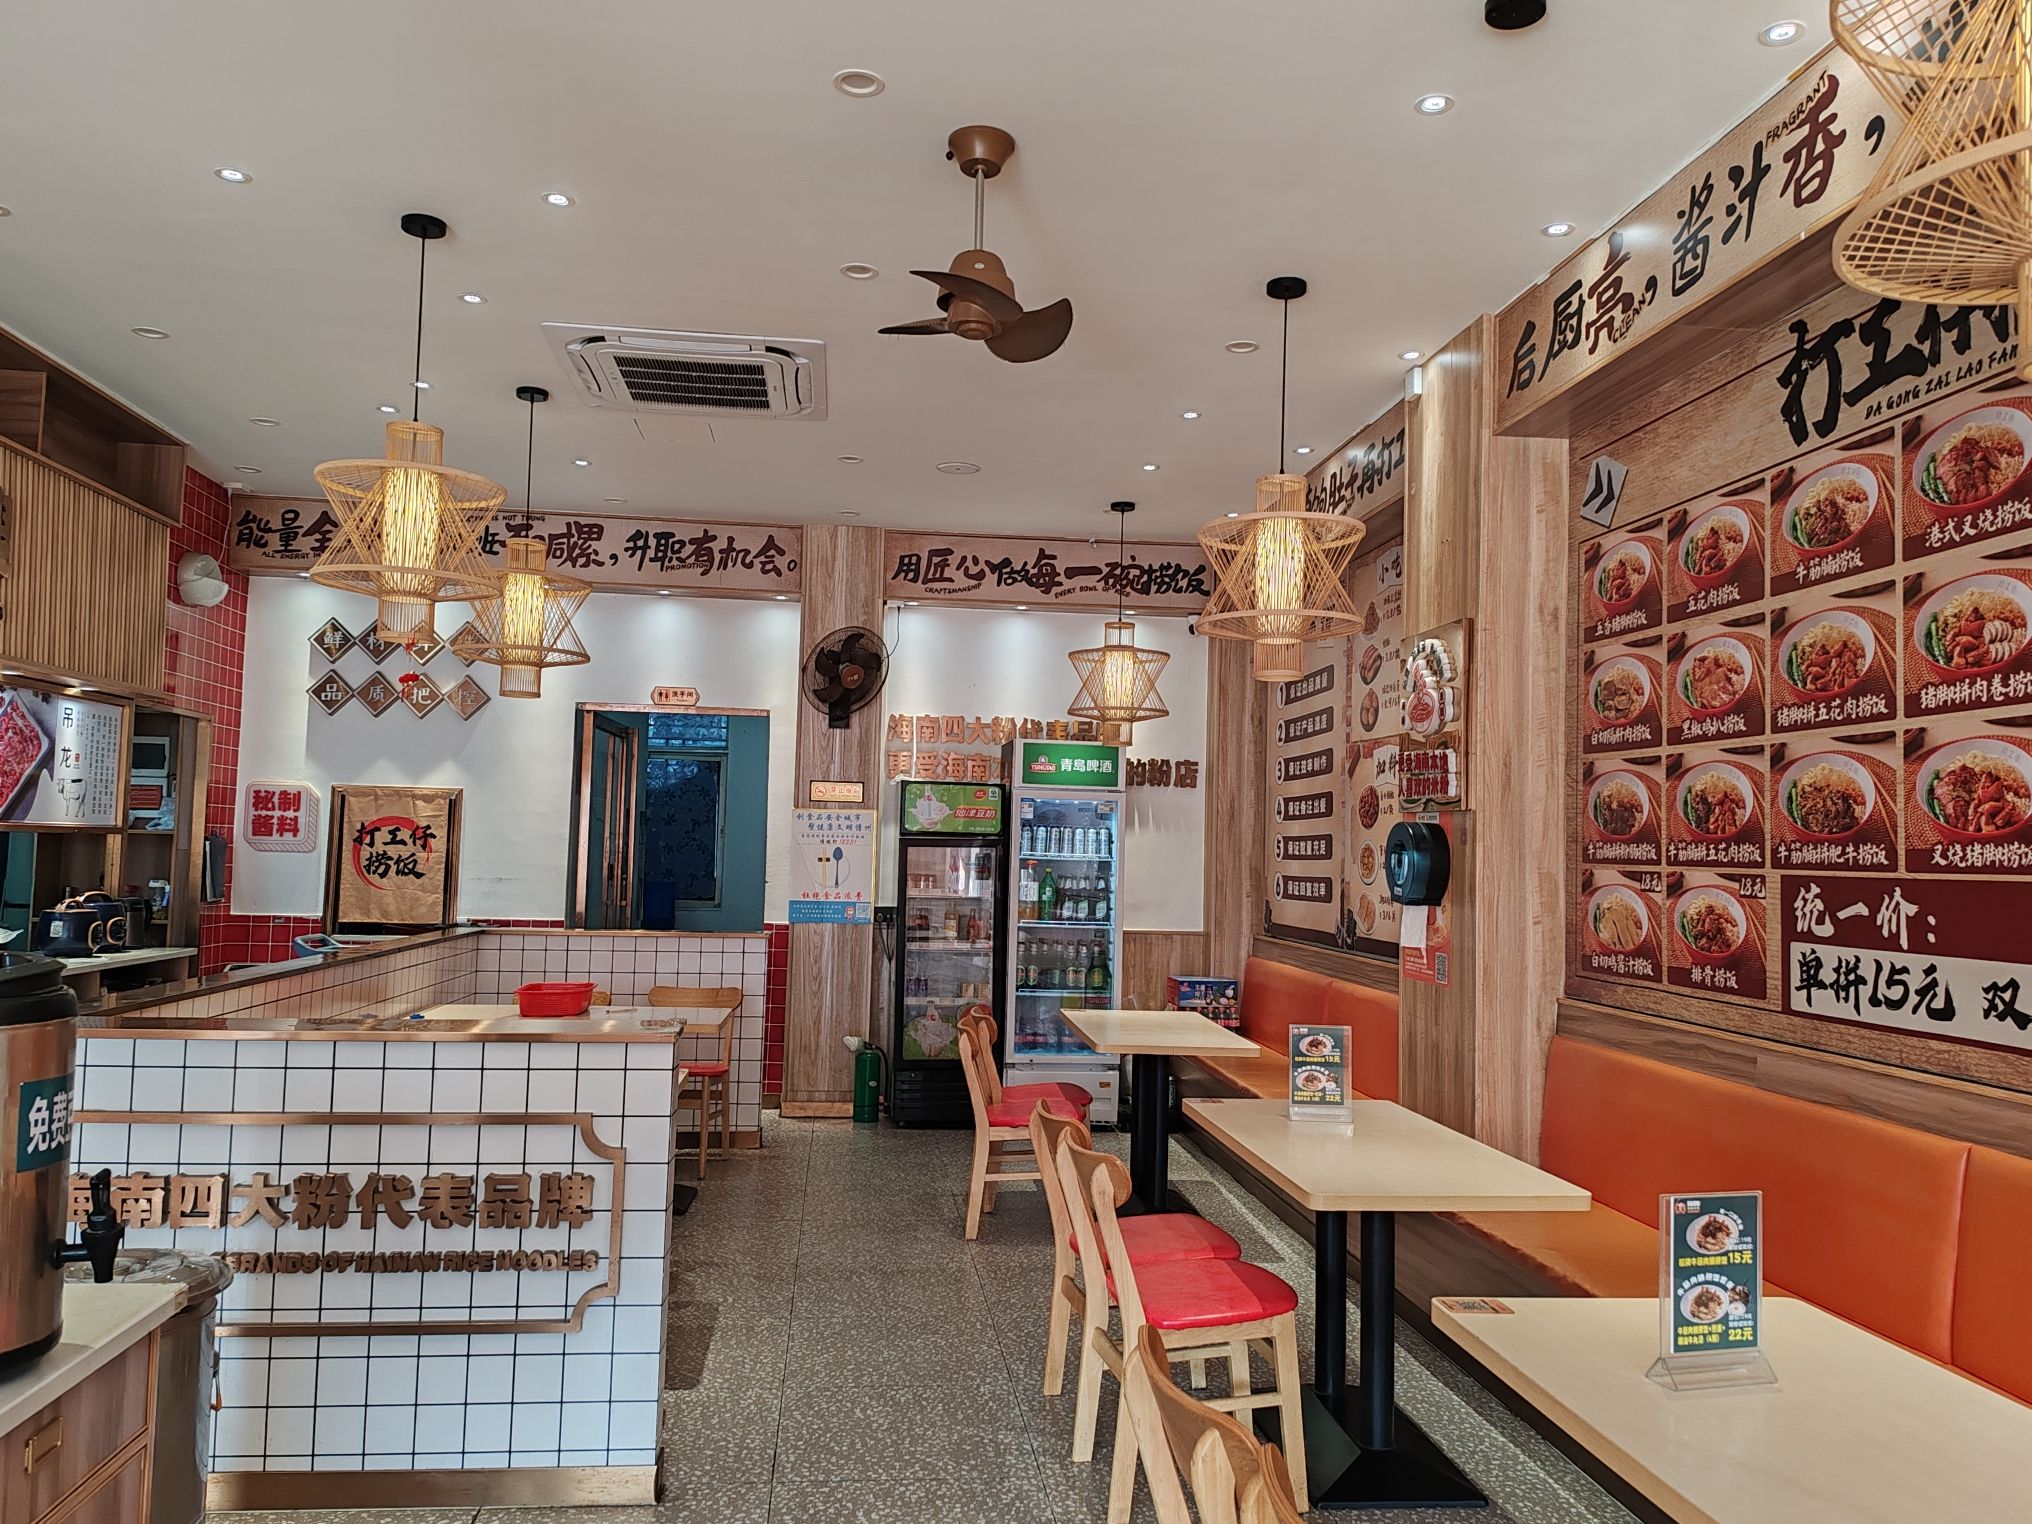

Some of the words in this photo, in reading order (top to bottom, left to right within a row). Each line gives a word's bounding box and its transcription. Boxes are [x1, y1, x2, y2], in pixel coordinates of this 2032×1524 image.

[1764, 69, 1827, 148] FRAGRANT
[1612, 293, 1646, 344] CLEAN
[1864, 404, 1882, 420] DA
[1886, 384, 1921, 410] GONG
[1925, 371, 1951, 395] ZAI
[1955, 358, 1983, 382] LAO
[1988, 343, 2019, 369] FAN
[665, 562, 710, 572] PROMOTION
[924, 582, 982, 595] CRAFTSMANSHIP
[1054, 586, 1077, 599] EVERY
[1079, 585, 1099, 593] BOWL
[671, 690, 694, 698] 洗手间
[886, 714, 1102, 743] 海南四大粉代表品
[1060, 758, 1113, 773] 青岛啤酒
[252, 790, 302, 813] 秘制
[251, 814, 300, 837] 酱料
[352, 822, 438, 851] 打工仔
[362, 851, 426, 880] 捞饭
[1739, 877, 1765, 898] 18元
[1690, 964, 1739, 989] 排骨捞饭
[1794, 948, 1956, 1025] 单拼15元
[322, 1250, 355, 1273] OF
[355, 1251, 442, 1274] HAINAN
[442, 1250, 494, 1273] RICE
[495, 1249, 600, 1273] NOODLES
[1728, 1251, 1753, 1264] 15元
[1728, 1327, 1753, 1341] 22元
